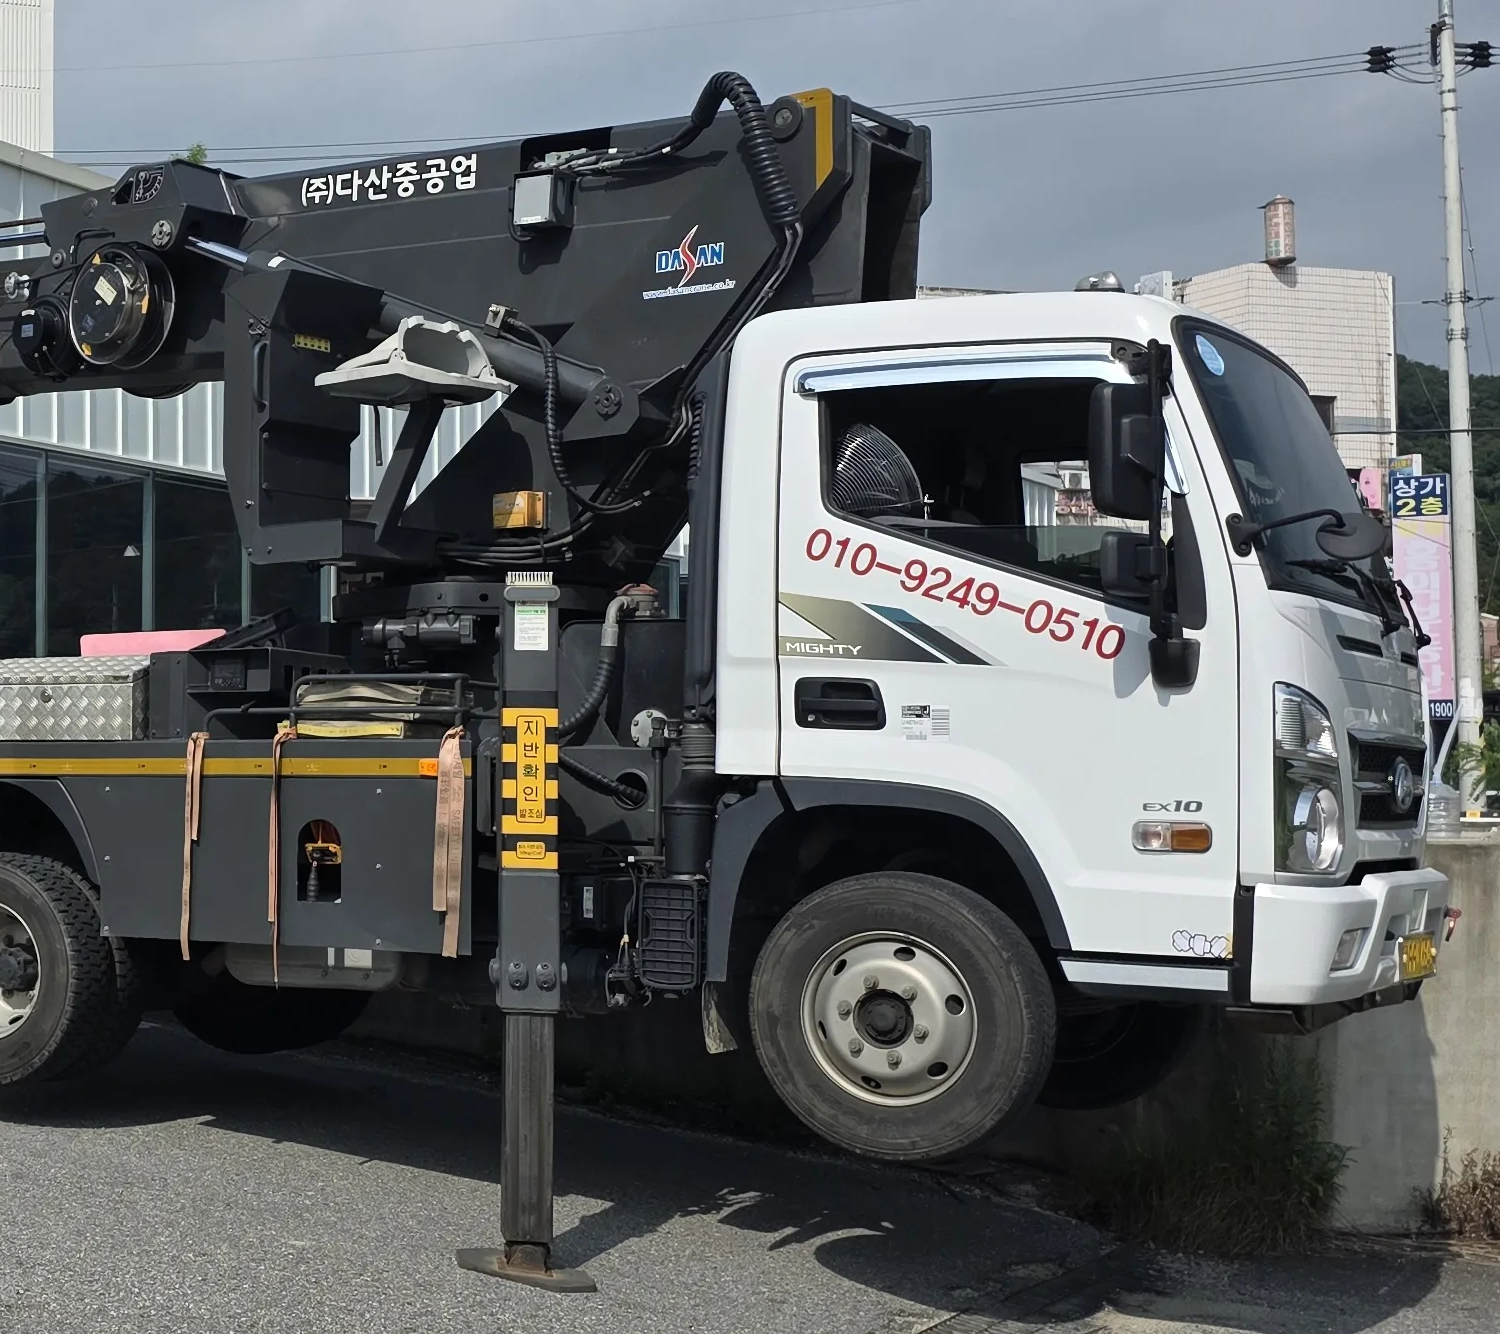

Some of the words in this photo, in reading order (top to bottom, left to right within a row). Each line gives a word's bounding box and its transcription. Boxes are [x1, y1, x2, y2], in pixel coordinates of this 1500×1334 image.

[301, 153, 478, 207] (주)다산중공업
[655, 224, 725, 288] DASAN
[1393, 477, 1445, 497] 상가
[1396, 496, 1444, 516] 2층
[805, 527, 1126, 660] 010-9249-0510
[785, 641, 863, 656] MIGHTY
